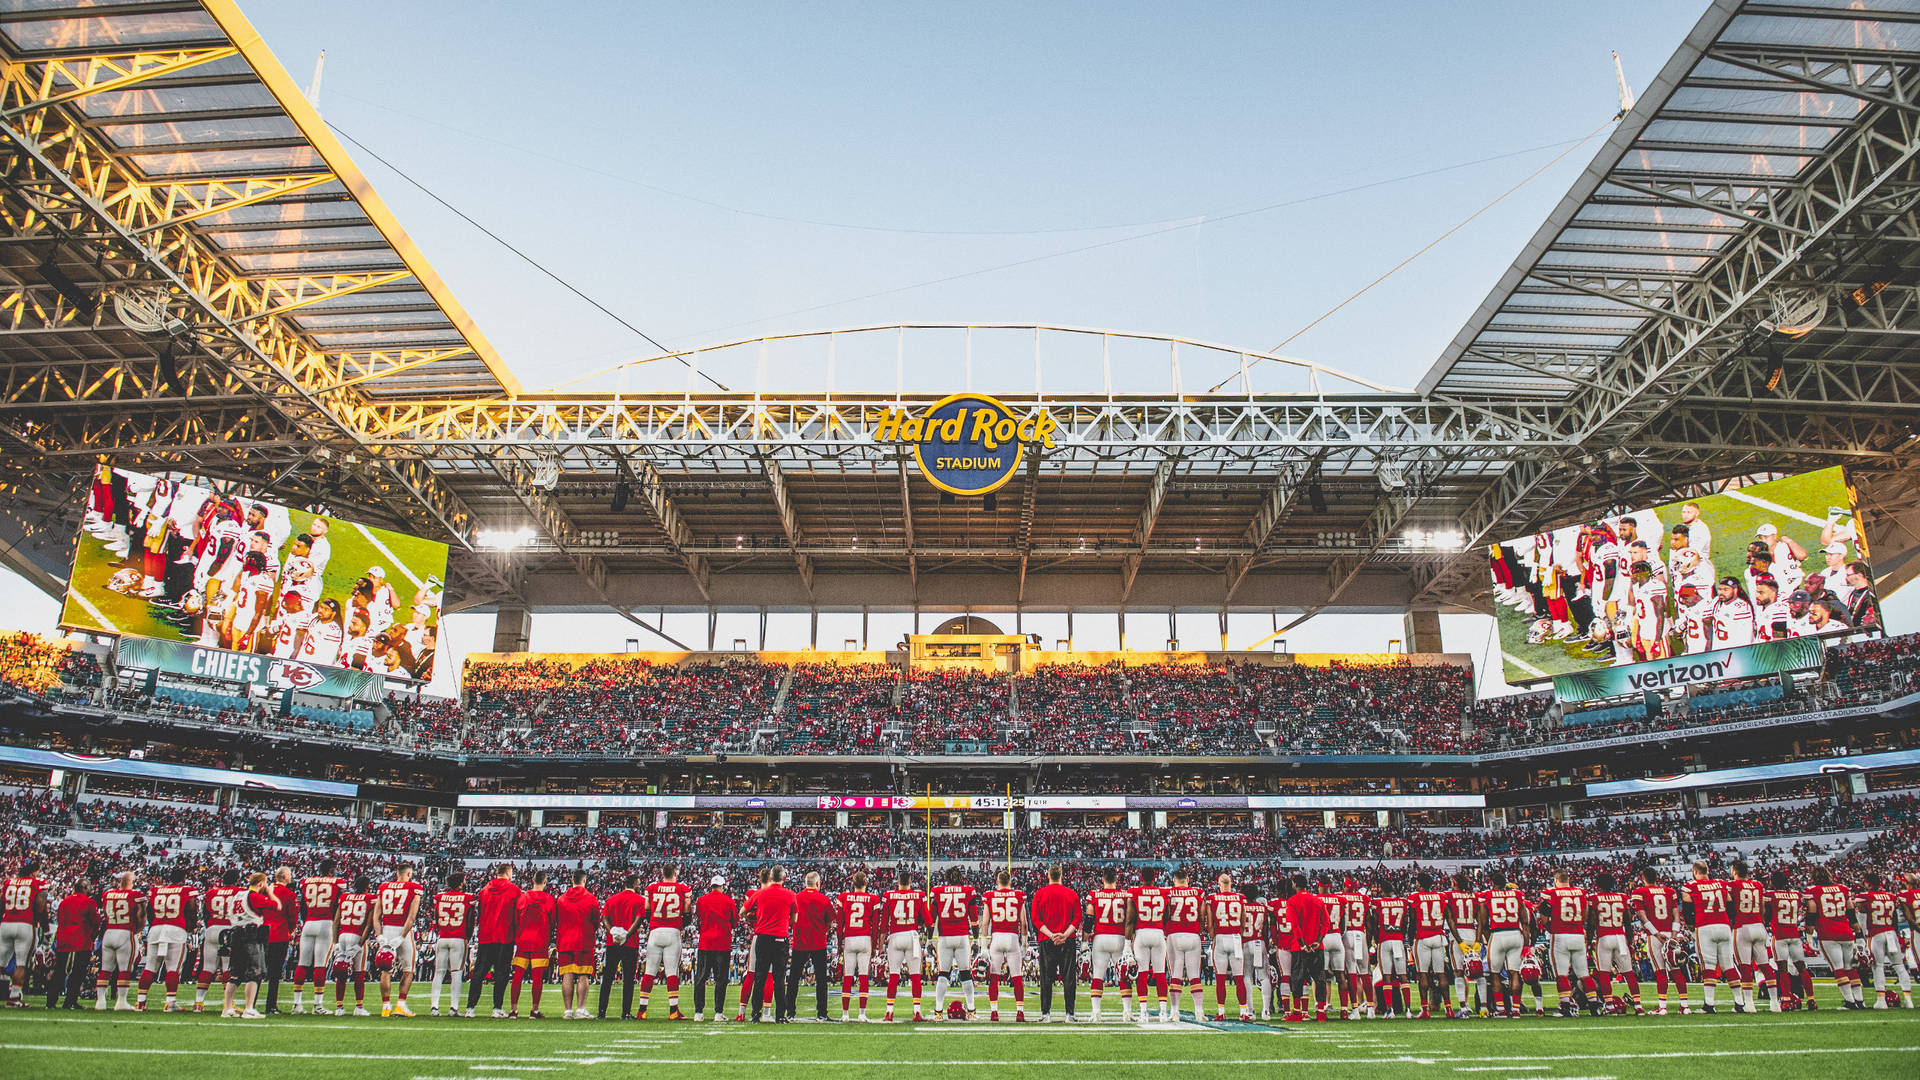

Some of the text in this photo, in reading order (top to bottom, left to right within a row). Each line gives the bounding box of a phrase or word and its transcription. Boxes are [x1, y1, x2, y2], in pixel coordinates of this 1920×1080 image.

[874, 408, 1056, 449] Hard Rock
[936, 457, 1001, 470] STADIUM
[191, 648, 261, 682] CHIEFS
[1628, 660, 1723, 690] verizon
[584, 796, 601, 807] TO
[612, 796, 663, 807] MIAMI
[975, 798, 1010, 807] 45:12
[1284, 796, 1367, 807] WELCOME
[1378, 796, 1396, 807] TO
[5, 886, 32, 911] 98
[154, 894, 181, 919] 99
[305, 883, 333, 908] 92
[381, 889, 409, 915] 87
[652, 893, 680, 918] 72
[940, 893, 966, 918] 75
[1653, 895, 1667, 920] 8
[1702, 889, 1726, 913] 71
[1739, 889, 1760, 913] 81
[1820, 893, 1846, 918] 62
[341, 900, 367, 926] 29
[438, 902, 465, 927] 53
[850, 903, 865, 928] 2
[893, 900, 916, 925] 41
[991, 897, 1018, 922] 56
[1098, 898, 1125, 923] 76
[1137, 896, 1165, 922] 52
[1171, 897, 1198, 922] 73
[1215, 902, 1242, 927] 49
[1381, 907, 1404, 927] 17
[1420, 901, 1443, 927] 14
[1456, 900, 1474, 924] 11
[1491, 897, 1518, 923] 59
[1560, 897, 1583, 921] 61
[1599, 902, 1624, 928] 26
[1777, 900, 1798, 924] 21
[1871, 900, 1894, 925] 23
